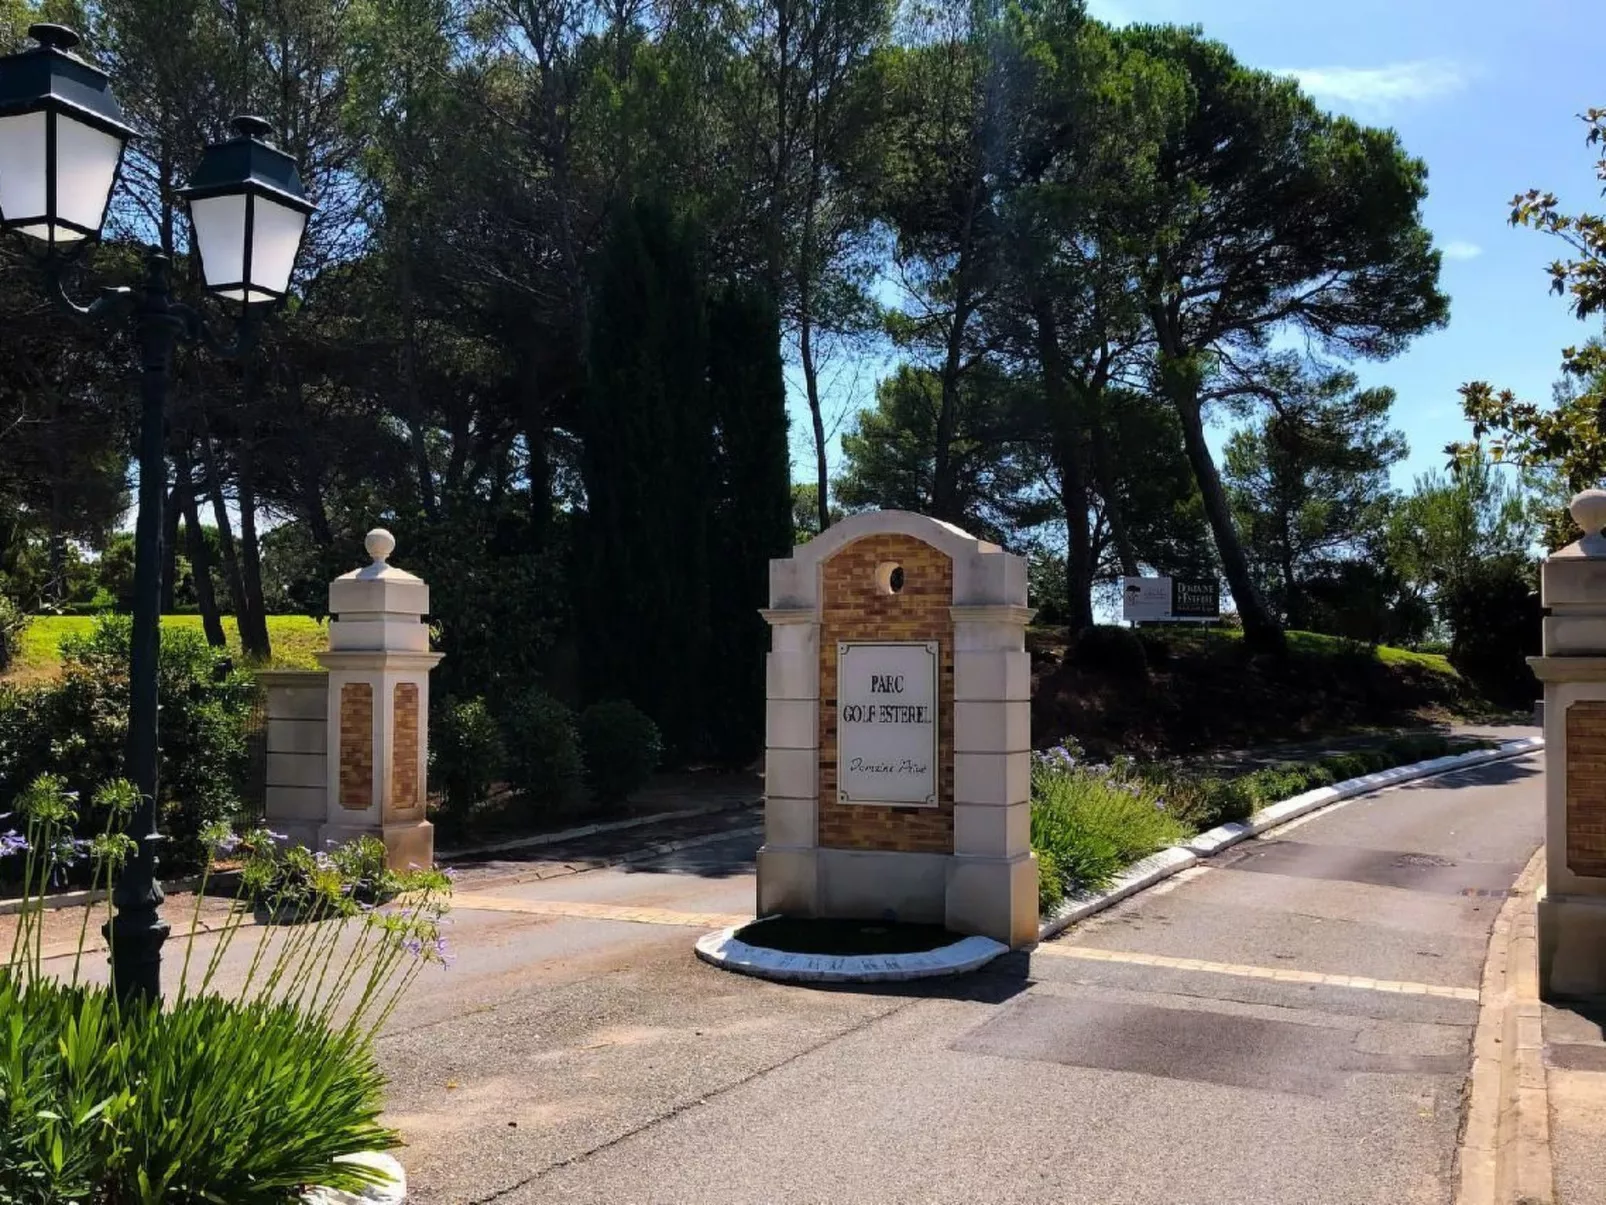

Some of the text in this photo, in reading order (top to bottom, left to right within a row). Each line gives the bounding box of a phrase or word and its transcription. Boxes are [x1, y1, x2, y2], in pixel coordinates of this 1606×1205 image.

[871, 675, 905, 694] PARC
[843, 705, 932, 724] GOLF ESTEREL
